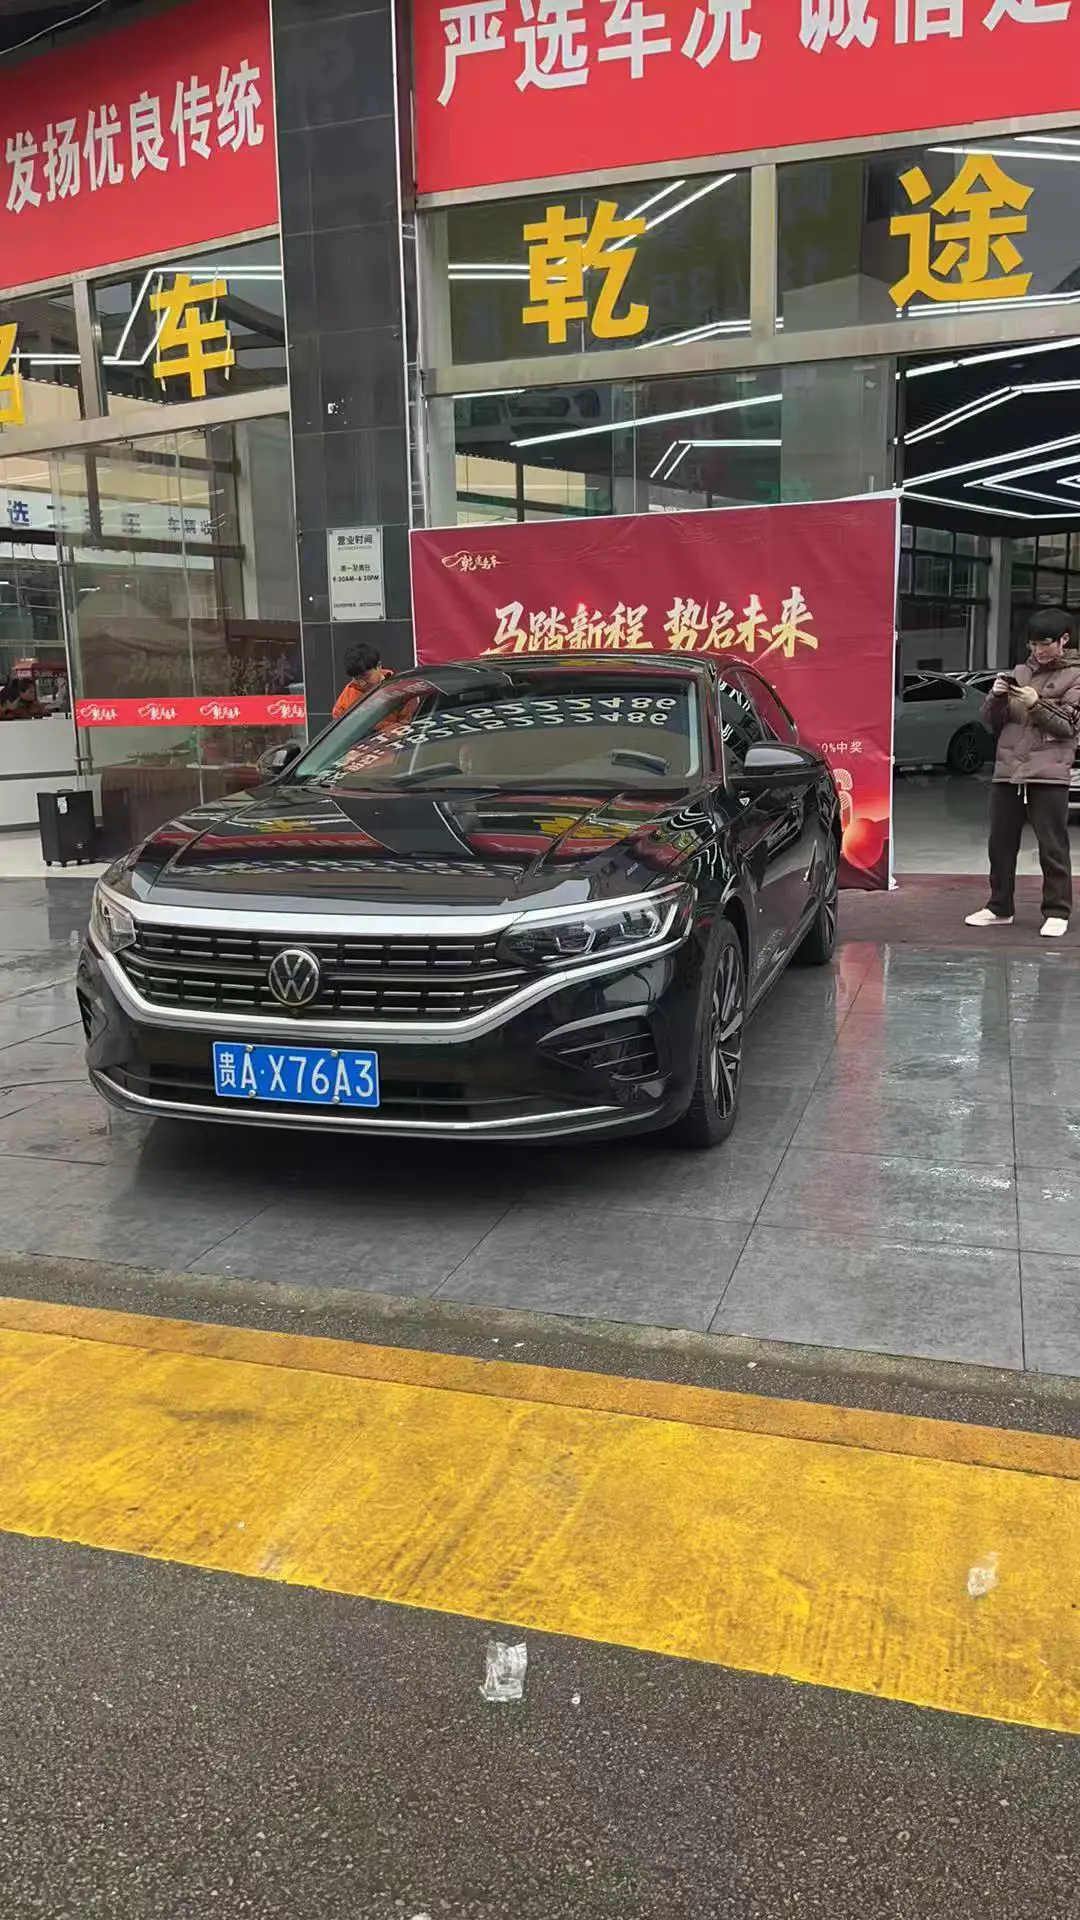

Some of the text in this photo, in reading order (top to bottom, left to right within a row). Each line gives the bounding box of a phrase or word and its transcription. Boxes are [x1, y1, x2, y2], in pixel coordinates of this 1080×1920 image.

[437, 0, 762, 107] 严选车况
[5, 59, 264, 214] 发扬优良传统
[522, 154, 1034, 344] 乾 途
[149, 273, 235, 397] 车
[337, 534, 373, 545] 营业时间
[482, 586, 819, 657] 马踏新程 势启未来
[816, 741, 863, 754] 0%中奖
[218, 1051, 375, 1098] 贵A·X76A3
